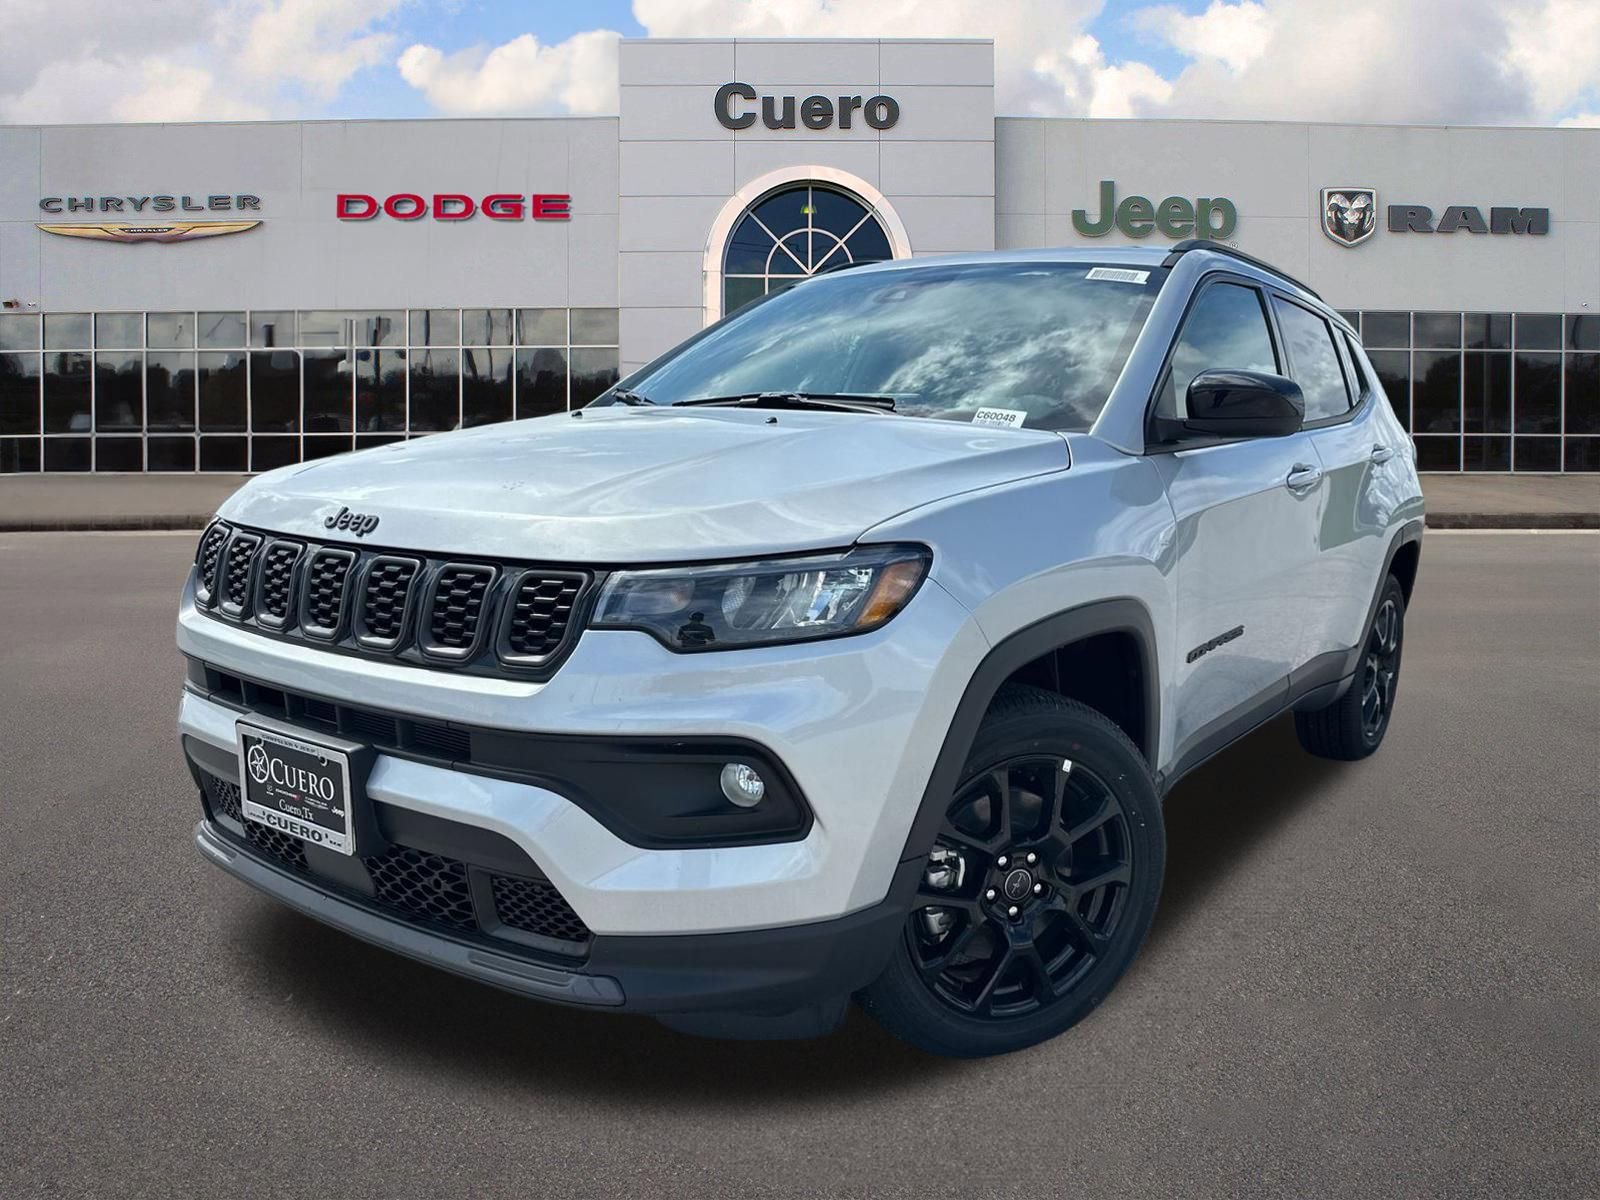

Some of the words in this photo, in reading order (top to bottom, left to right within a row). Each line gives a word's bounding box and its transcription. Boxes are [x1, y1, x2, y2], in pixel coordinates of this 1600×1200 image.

[714, 82, 900, 129] Cuero
[39, 194, 261, 213] CHRYSLER
[336, 193, 571, 220] DODGE
[1072, 180, 1237, 240] Jeep
[1388, 205, 1550, 235] RAM
[976, 411, 1017, 423] C60048
[324, 506, 380, 537] Jeep
[270, 758, 335, 801] CUERO
